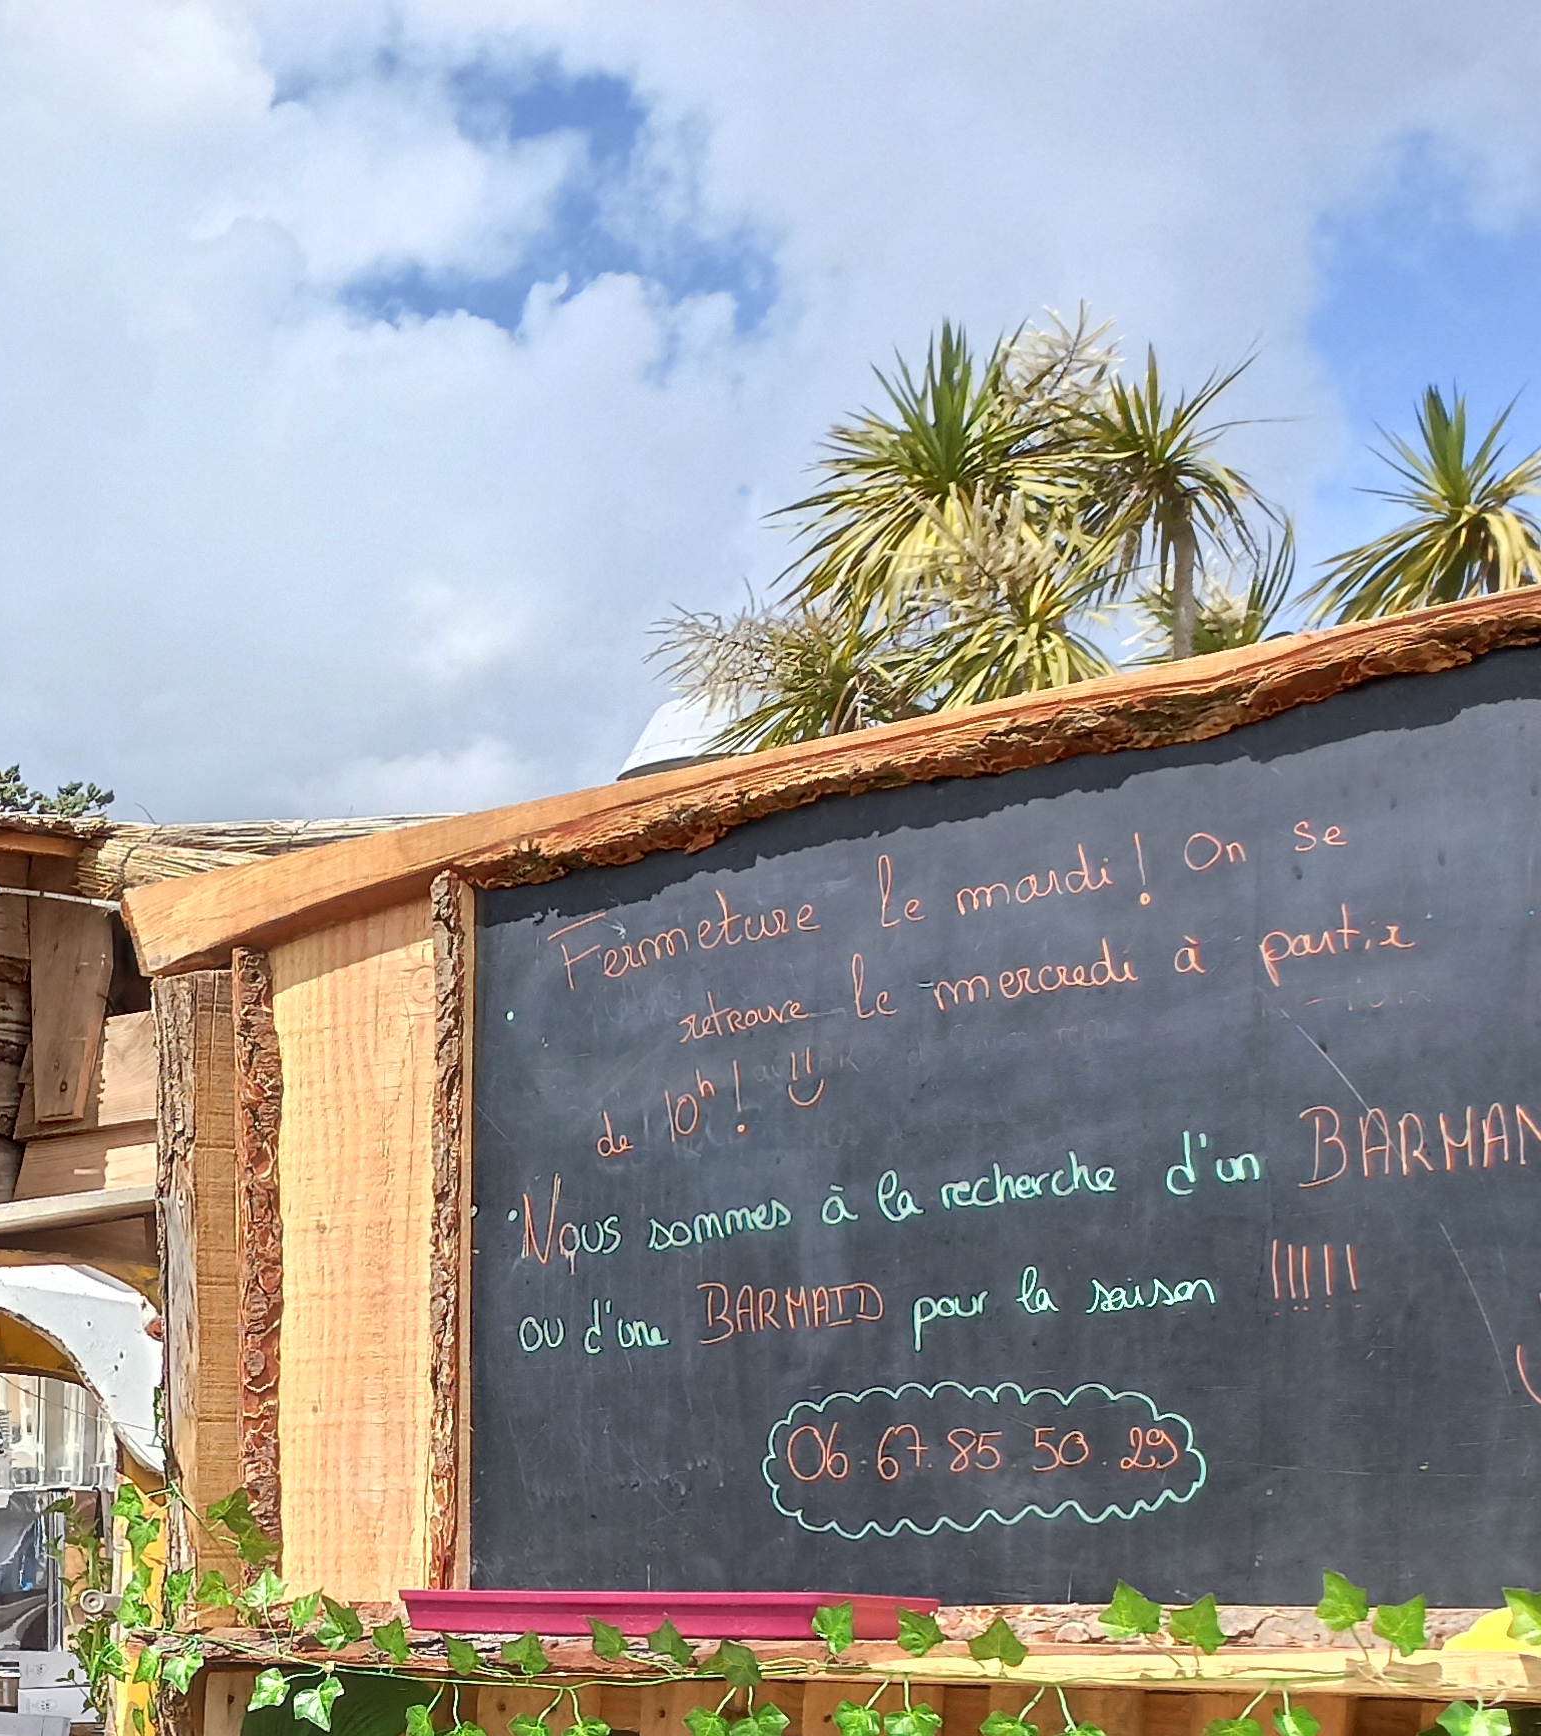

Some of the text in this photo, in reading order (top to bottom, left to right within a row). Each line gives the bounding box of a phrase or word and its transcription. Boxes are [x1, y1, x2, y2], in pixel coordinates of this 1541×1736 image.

[548, 890, 821, 991] Fermeture
[877, 854, 926, 928] le
[956, 842, 1113, 917] mardi
[1183, 831, 1247, 872] On
[678, 992, 810, 1045] retrouve
[851, 953, 898, 1020] le
[932, 938, 1140, 1011] mercredi
[1173, 933, 1207, 975] à
[596, 1111, 634, 1158] de
[520, 1172, 623, 1275] Nous
[648, 1197, 793, 1252] sommes
[821, 1184, 859, 1226] à
[876, 1169, 925, 1223] la
[939, 1150, 1118, 1209] recherche
[1165, 1130, 1262, 1197] d'un
[581, 1298, 671, 1355] d'une
[696, 1280, 885, 1345] BARMAID
[910, 1289, 991, 1353] pour
[1016, 1265, 1060, 1316] la
[1085, 1277, 1217, 1315] saison
